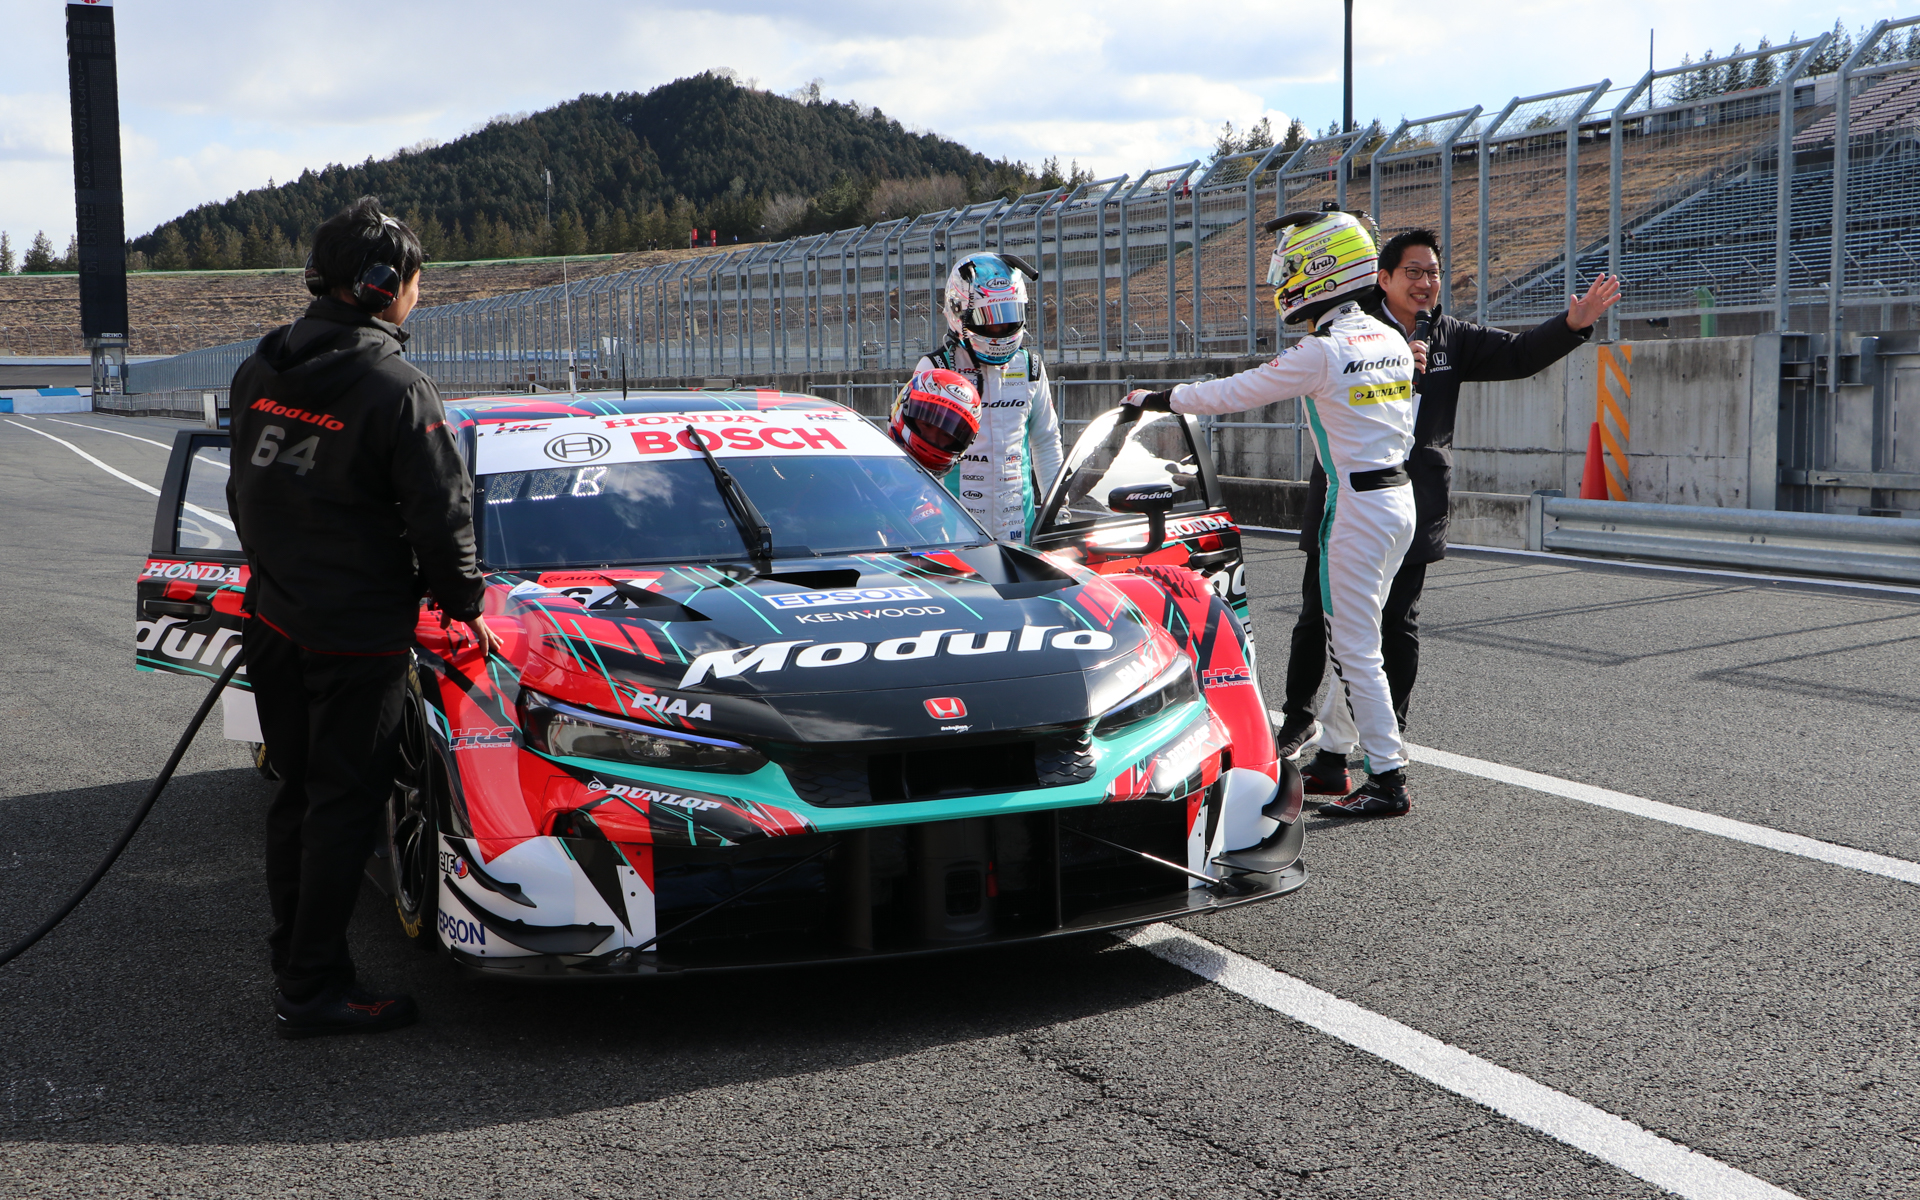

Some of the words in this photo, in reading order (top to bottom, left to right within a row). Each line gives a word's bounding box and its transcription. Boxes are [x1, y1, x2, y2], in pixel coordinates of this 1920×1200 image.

[1308, 256, 1332, 273] Arai
[990, 279, 1008, 287] Arai
[1345, 333, 1387, 346] HOND
[1343, 355, 1409, 374] Modulo
[1430, 365, 1452, 373] HONDA
[953, 386, 971, 399] Arai
[1366, 386, 1406, 399] DUNLOP
[250, 398, 344, 431] Modulo
[804, 413, 848, 421] HRC
[935, 397, 973, 423] AUTOBACS
[494, 423, 552, 435] HRC
[601, 414, 768, 430] HONDA
[251, 424, 320, 476] 64
[630, 427, 848, 455] BOSCH
[962, 454, 989, 463] PIAA
[965, 490, 981, 498] Arai
[1126, 491, 1173, 500] Modulo
[1165, 515, 1236, 538] HONDA
[142, 562, 240, 583] HONDA
[769, 588, 926, 607] EPSON
[795, 606, 946, 624] KENWOOD
[678, 625, 1116, 690] Modulo
[1115, 654, 1158, 684] PIAA
[1202, 666, 1251, 686] HRC
[631, 691, 711, 721] PIAA
[449, 726, 514, 747] HRC
[449, 744, 479, 752] Honda
[606, 783, 722, 811] DUNLOP
[438, 908, 486, 945] EPSON
